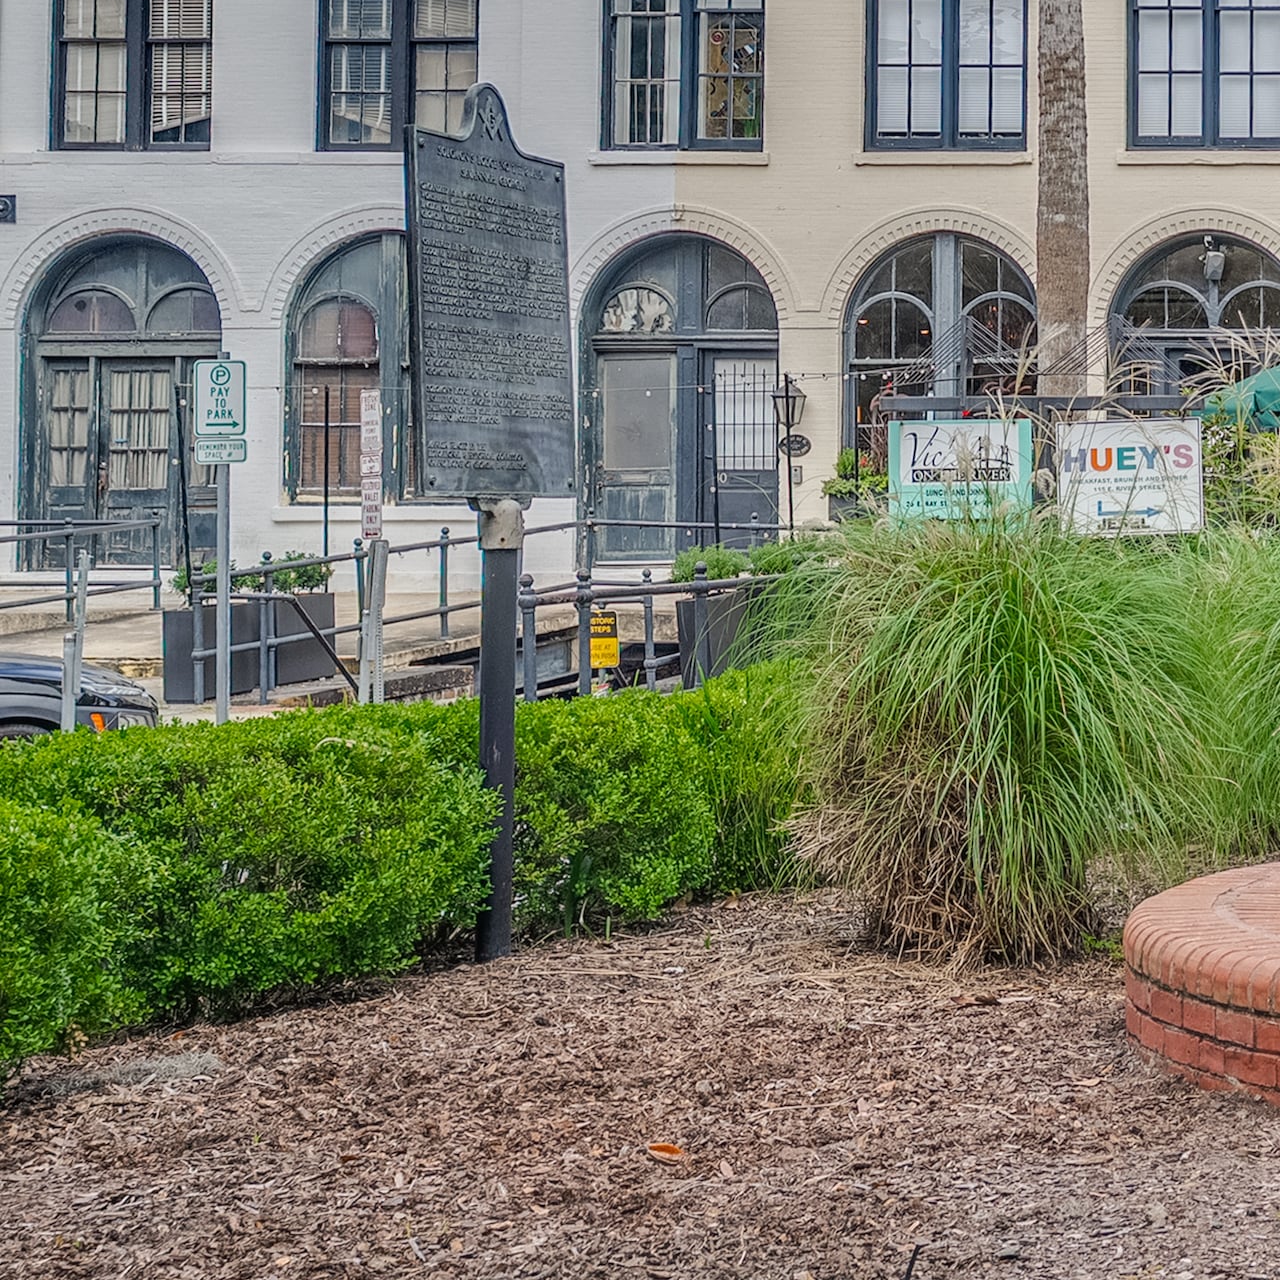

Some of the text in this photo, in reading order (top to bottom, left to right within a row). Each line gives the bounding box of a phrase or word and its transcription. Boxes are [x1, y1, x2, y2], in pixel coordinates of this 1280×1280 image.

[215, 370, 226, 381] P
[210, 387, 230, 397] PAY
[214, 398, 226, 408] TO
[207, 409, 234, 419] PARK
[199, 442, 243, 451] REMEMBER YOUR
[204, 451, 223, 459] SPACE
[1064, 444, 1194, 472] HUEY'S
